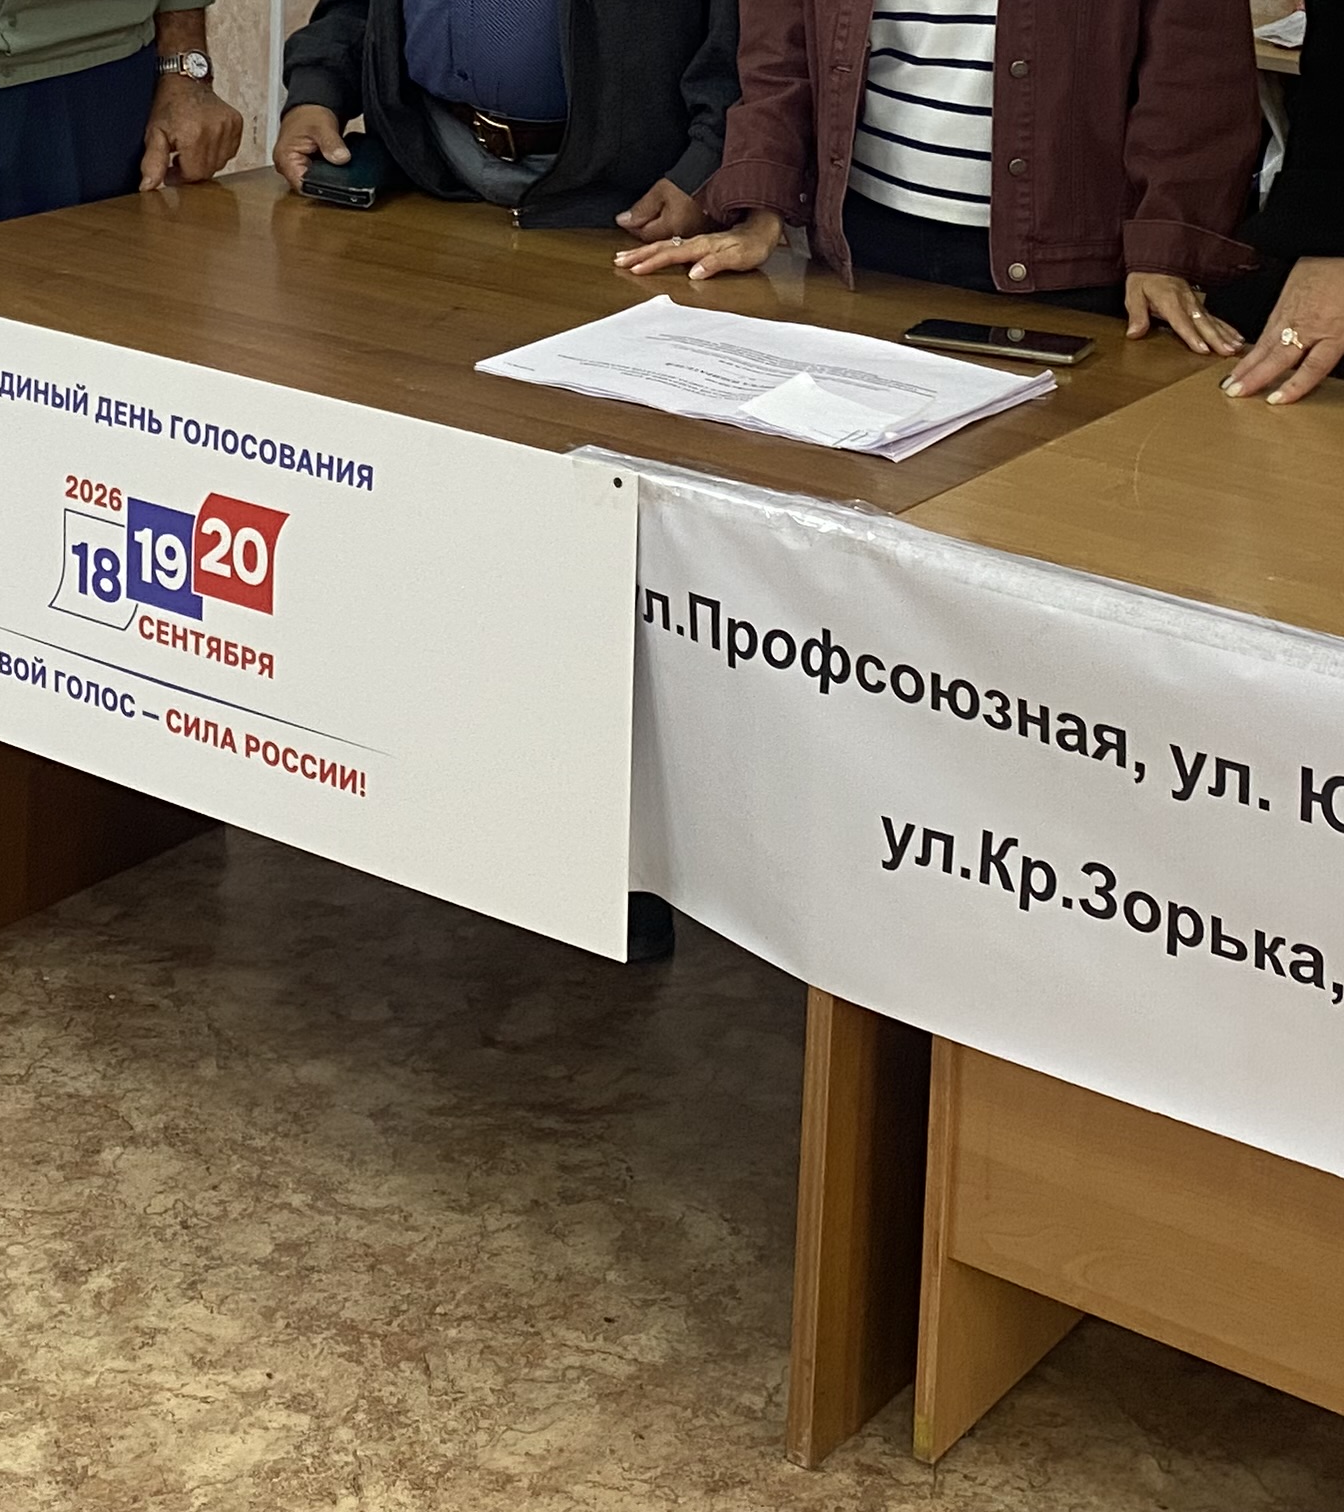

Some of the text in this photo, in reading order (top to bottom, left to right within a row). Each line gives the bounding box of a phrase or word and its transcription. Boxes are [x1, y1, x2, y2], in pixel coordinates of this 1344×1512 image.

[95, 397, 163, 434] ДЕНЬ
[169, 414, 375, 491] ГОЛОСОВАНИЯ
[64, 474, 123, 512] 2026
[71, 517, 269, 604] 18 19 20
[137, 615, 275, 680] СЕНТЯБРЯ
[54, 669, 136, 719] ГОЛОС
[165, 707, 238, 754] СИЛА
[244, 733, 367, 798] РОССИИ!
[636, 584, 1148, 784] л.Профсоюзная,
[1169, 743, 1272, 812] ул.
[880, 815, 1344, 1005] ул.Кр.Зорька,
